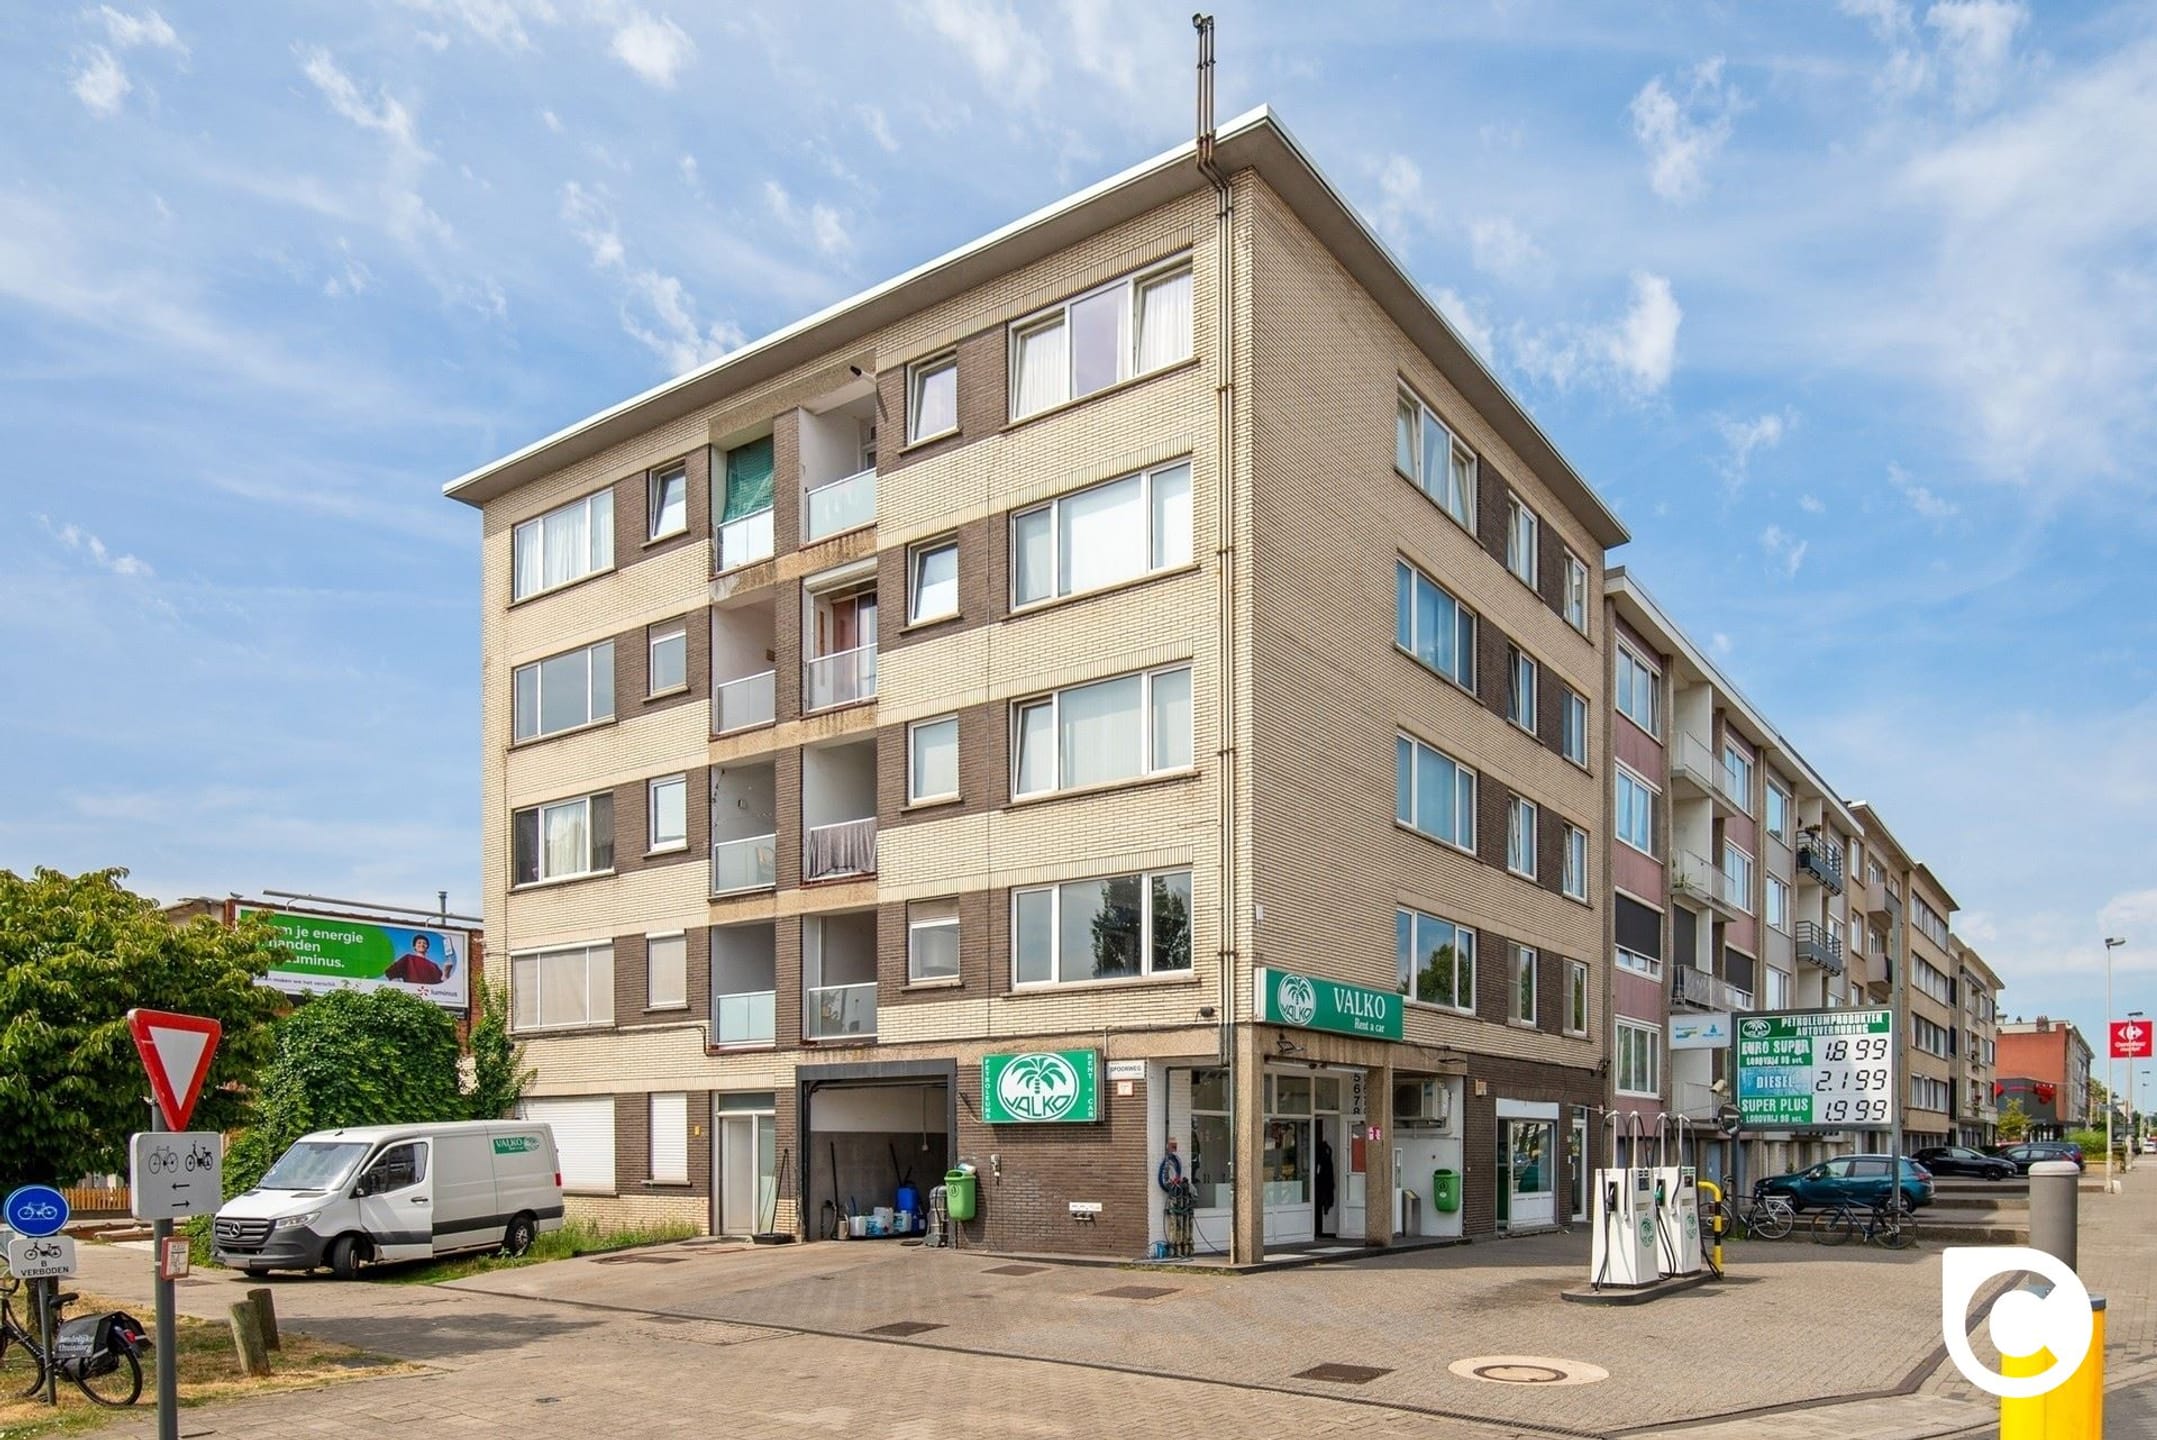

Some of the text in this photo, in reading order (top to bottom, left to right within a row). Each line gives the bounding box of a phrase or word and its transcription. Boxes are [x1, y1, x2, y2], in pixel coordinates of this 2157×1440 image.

[295, 925, 309, 939] je
[313, 929, 364, 944] energie
[1333, 987, 1386, 1019] VALKO
[1354, 1018, 1369, 1031] Rent
[1375, 1024, 1385, 1033] car
[1741, 1039, 1811, 1055] EURO SUPER
[1756, 1076, 1793, 1088] DIESEL
[1005, 1095, 1071, 1117] VALKO
[1742, 1098, 1808, 1112] SUPER PLUS
[495, 1138, 523, 1148] VALKO
[21, 1266, 69, 1276] VERBODEN
